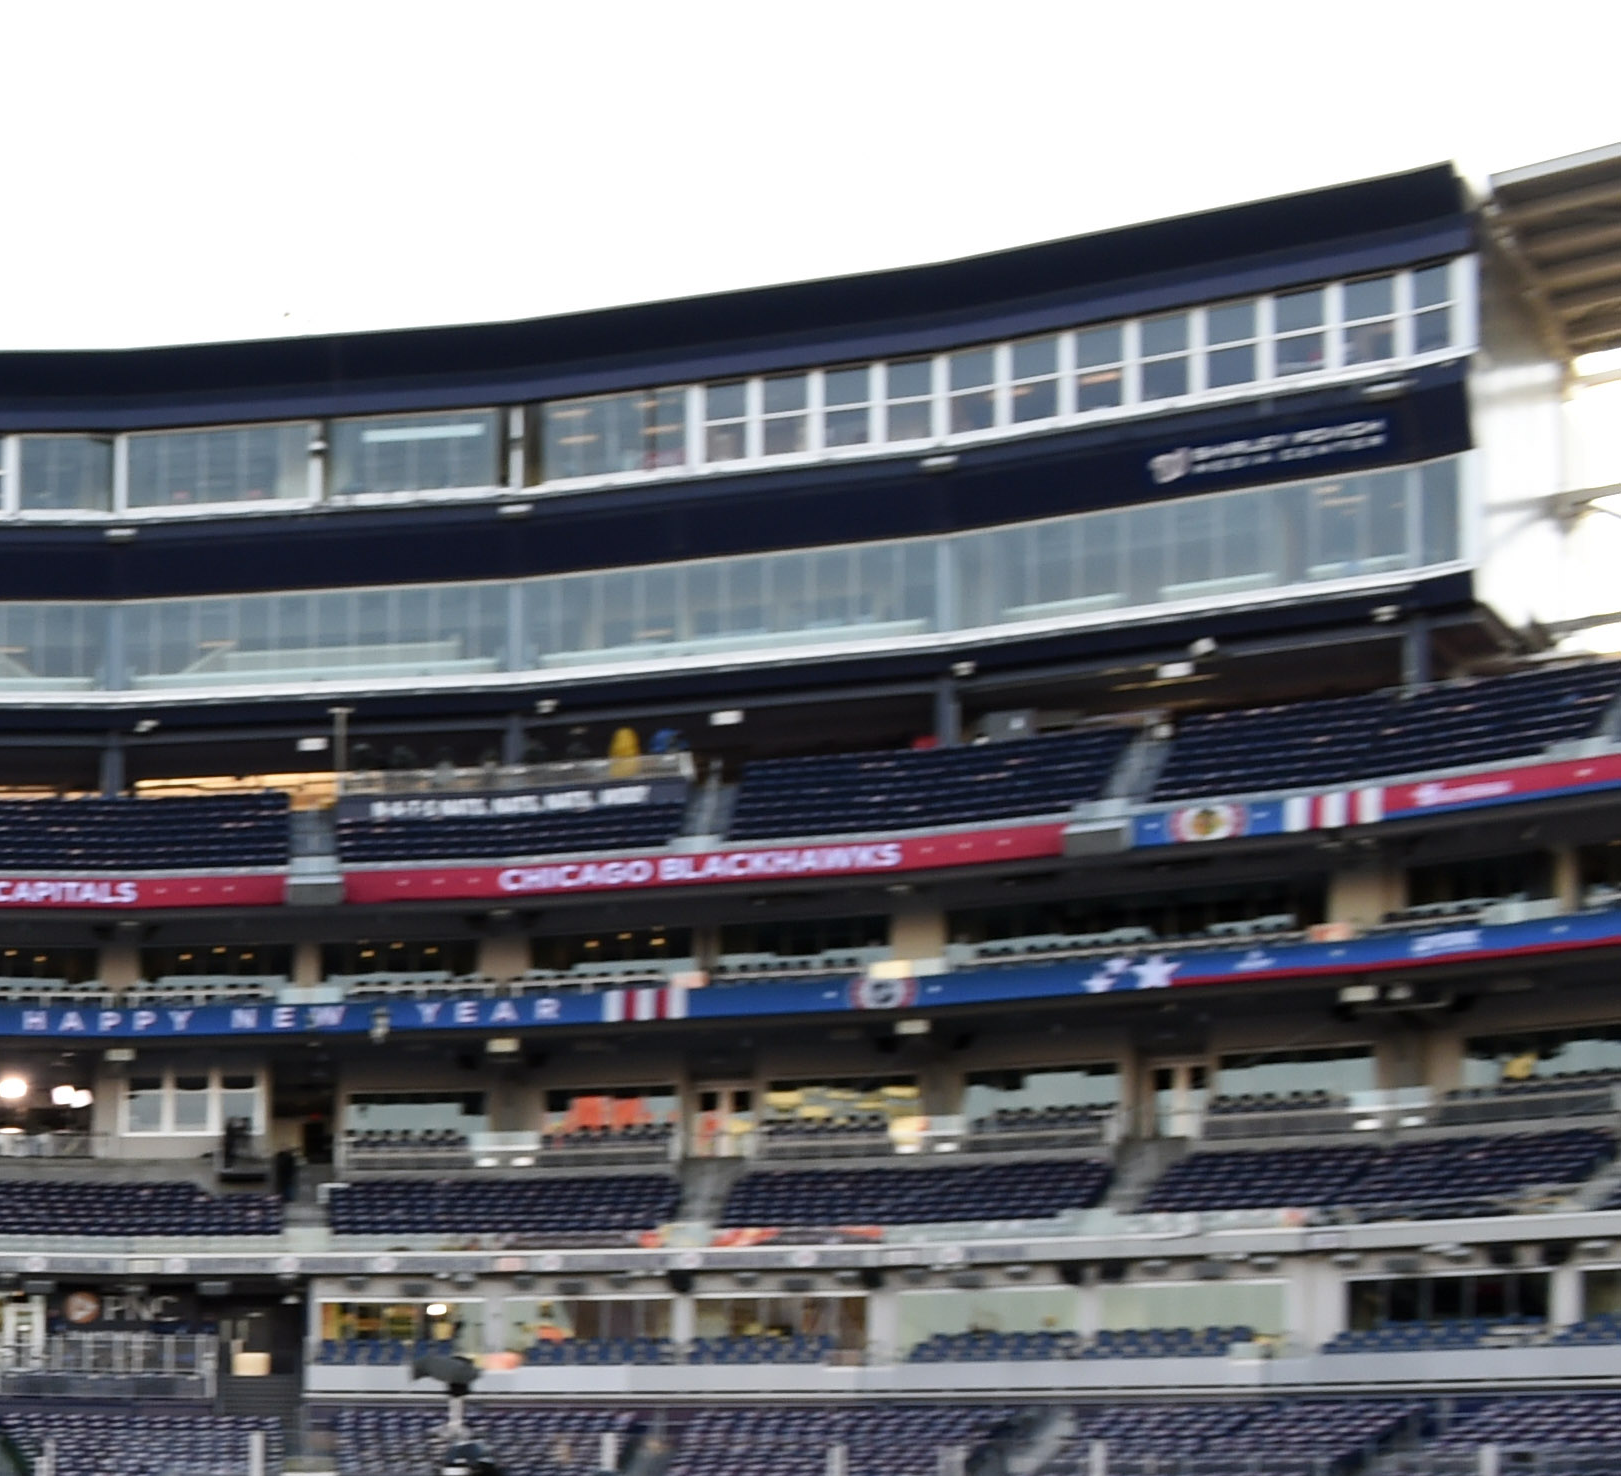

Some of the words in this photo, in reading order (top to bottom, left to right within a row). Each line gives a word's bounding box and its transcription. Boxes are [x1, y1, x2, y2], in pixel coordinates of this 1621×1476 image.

[497, 860, 653, 892] CHICAGO
[659, 842, 902, 882] BLACKHAWKS
[22, 1008, 196, 1032] HAPPY
[230, 1005, 349, 1030] NEW
[416, 996, 563, 1025] YEAR
